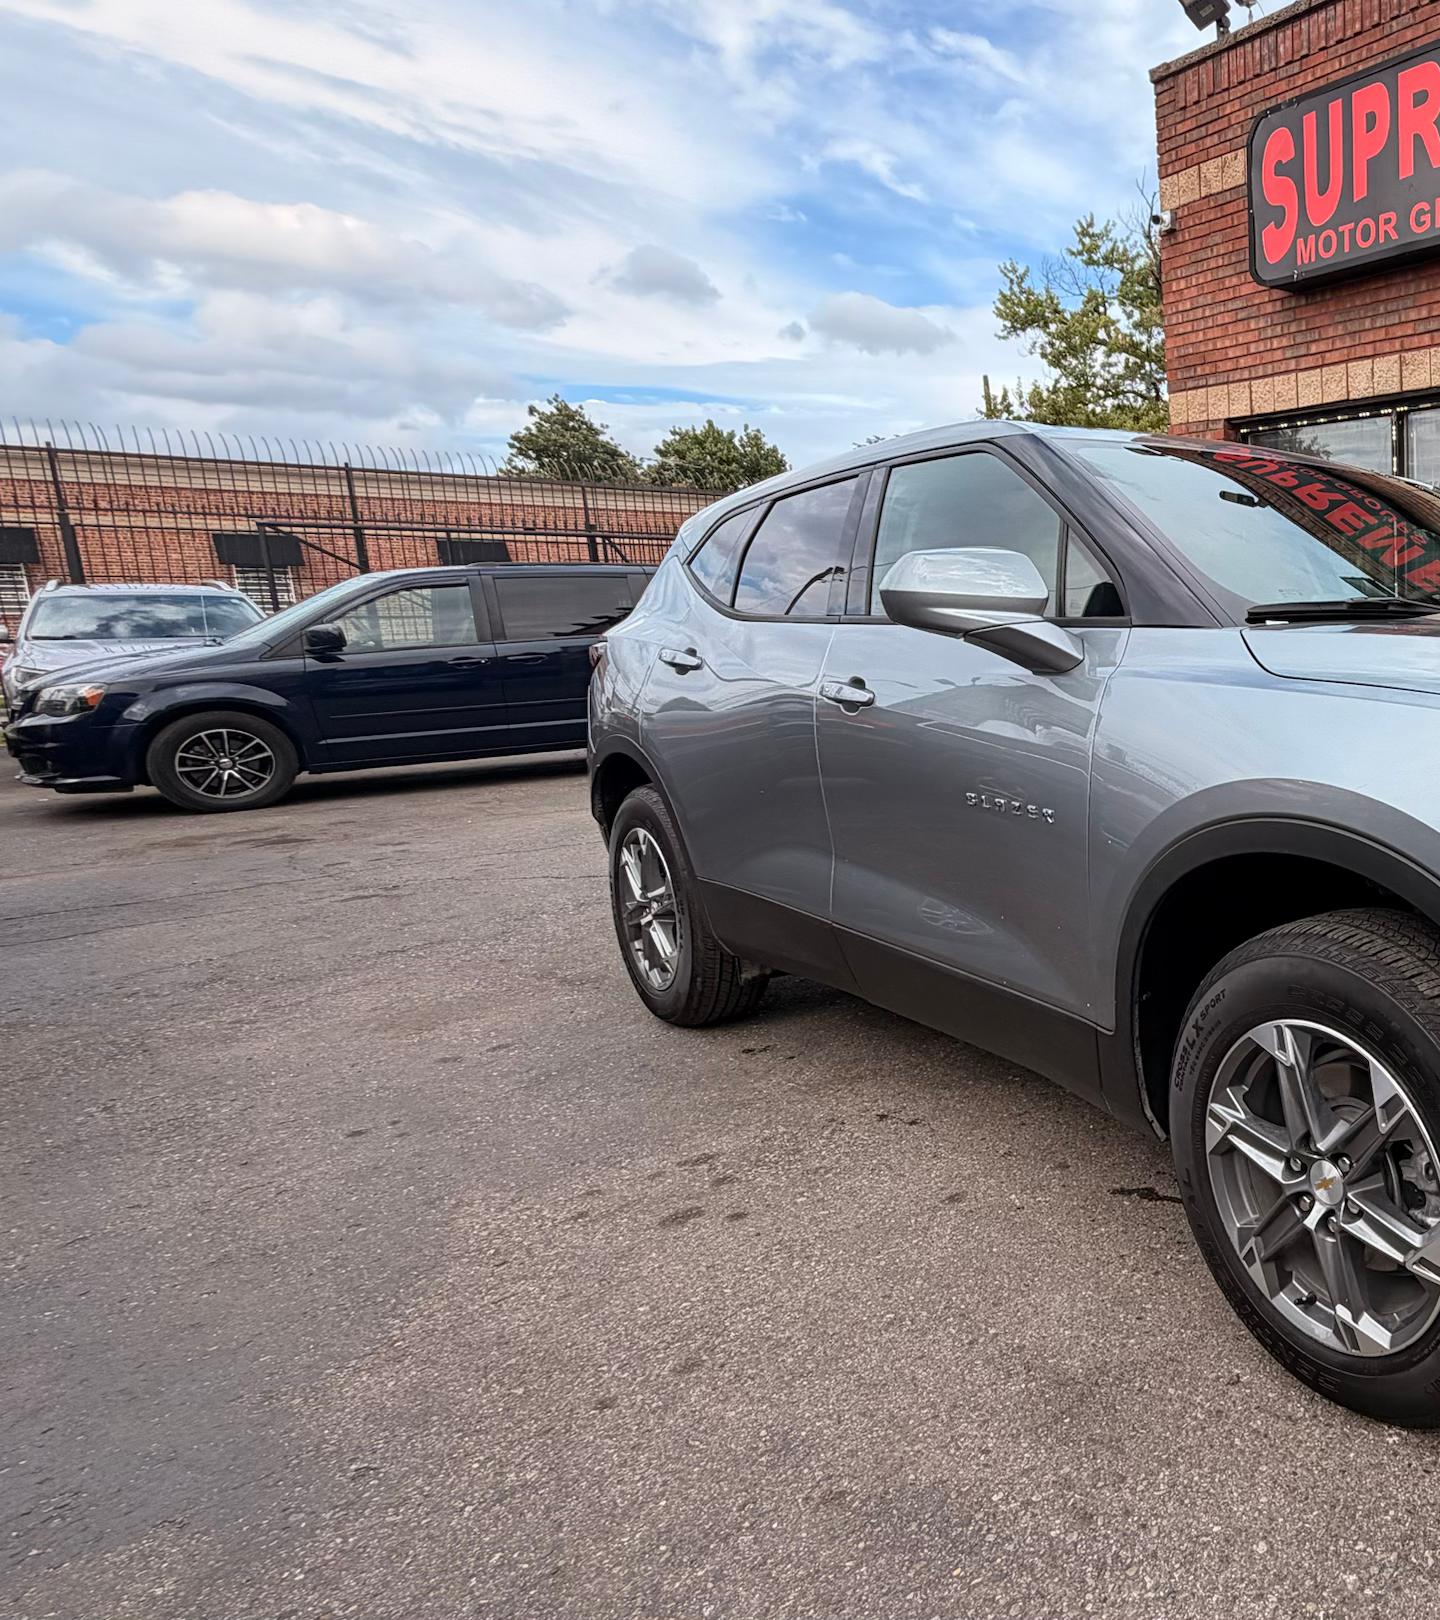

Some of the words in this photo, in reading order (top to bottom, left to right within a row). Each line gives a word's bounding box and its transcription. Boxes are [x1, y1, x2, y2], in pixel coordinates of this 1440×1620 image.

[1296, 211, 1398, 265] MOTOR
[966, 792, 1055, 824] BLAZER
[1200, 988, 1226, 1021] SPORT
